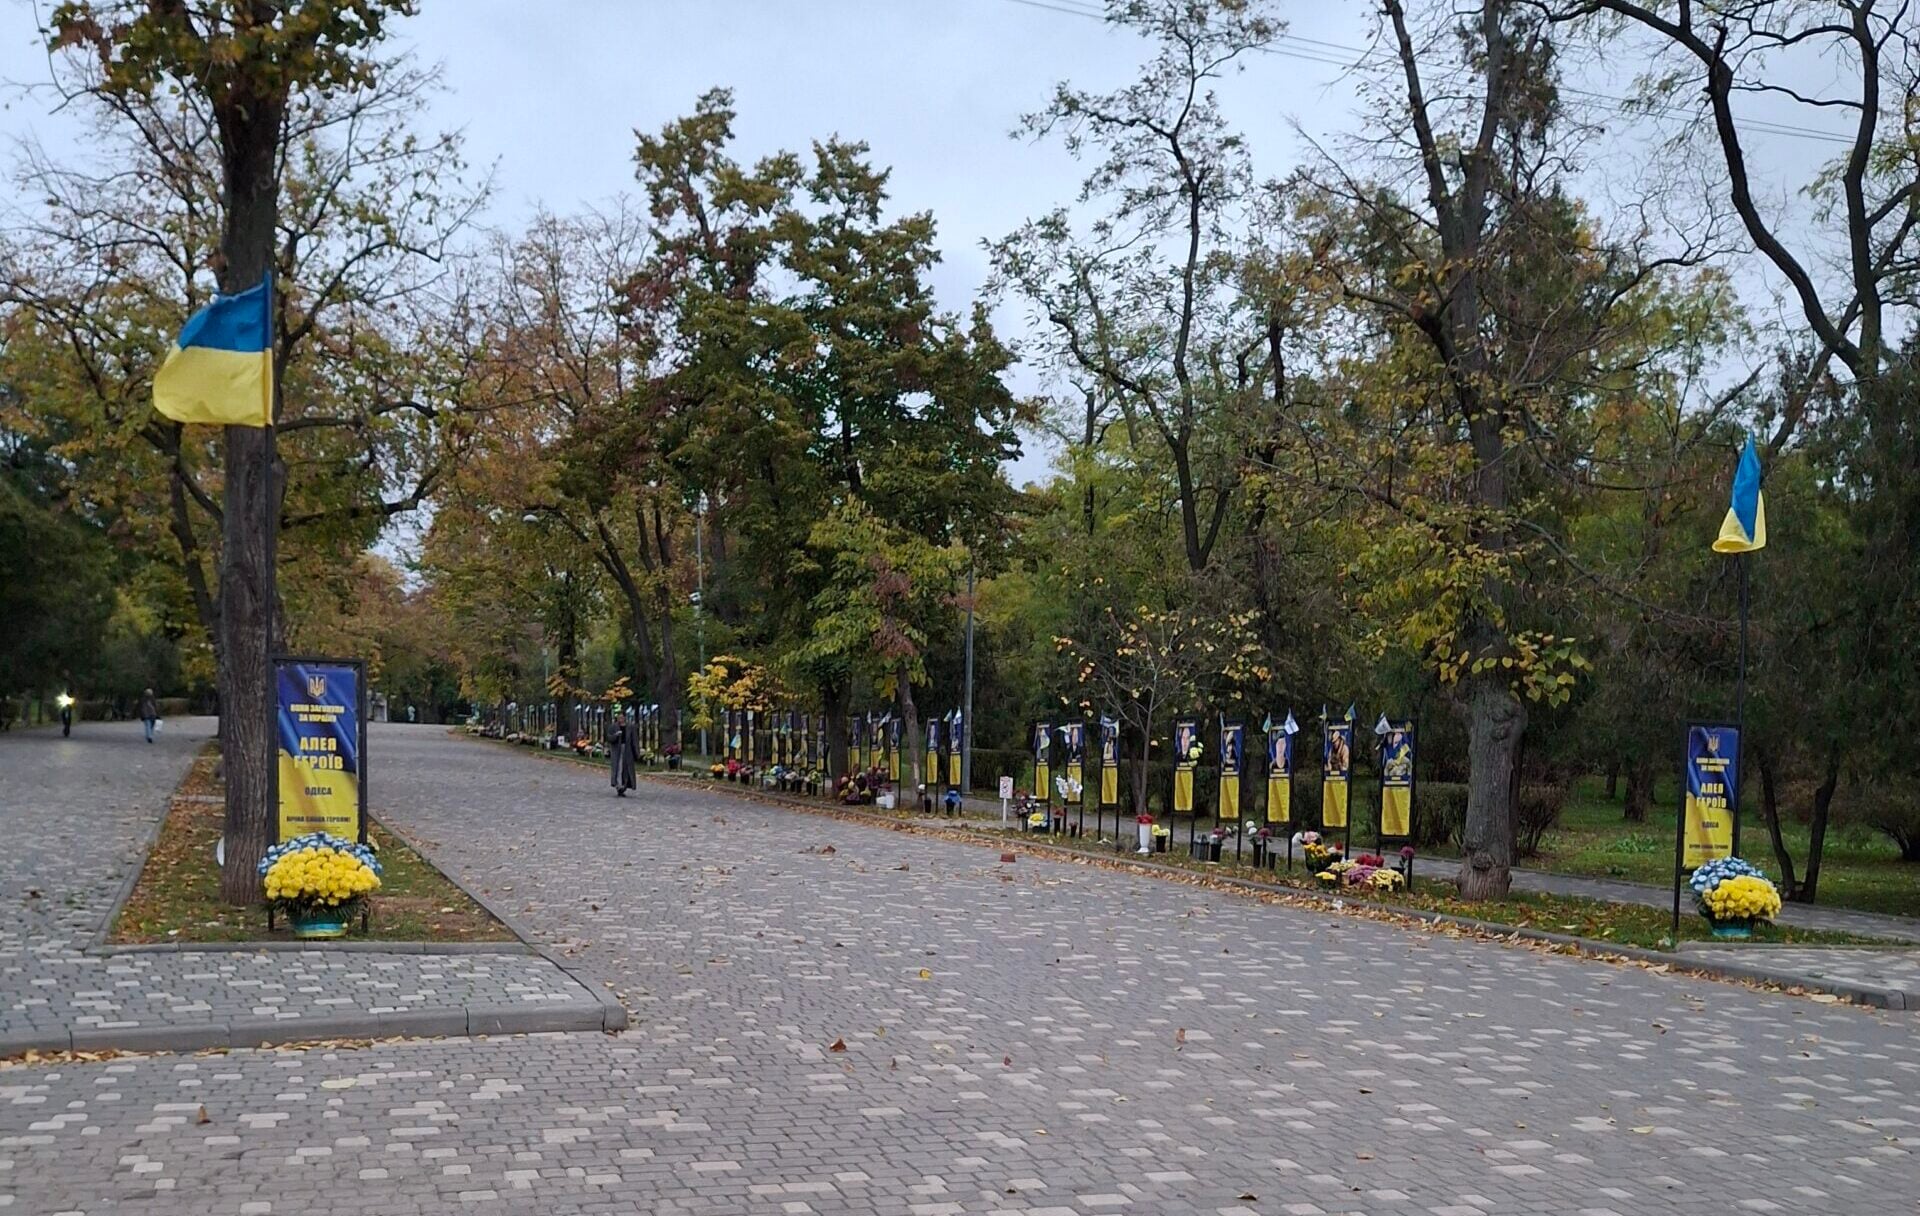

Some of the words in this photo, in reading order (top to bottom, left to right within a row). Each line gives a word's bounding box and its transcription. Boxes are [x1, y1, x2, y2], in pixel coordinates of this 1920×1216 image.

[300, 736, 337, 751] АЛЕЯ
[294, 754, 343, 769] ГЕРОЇВ
[304, 787, 332, 796] ОДЕСА
